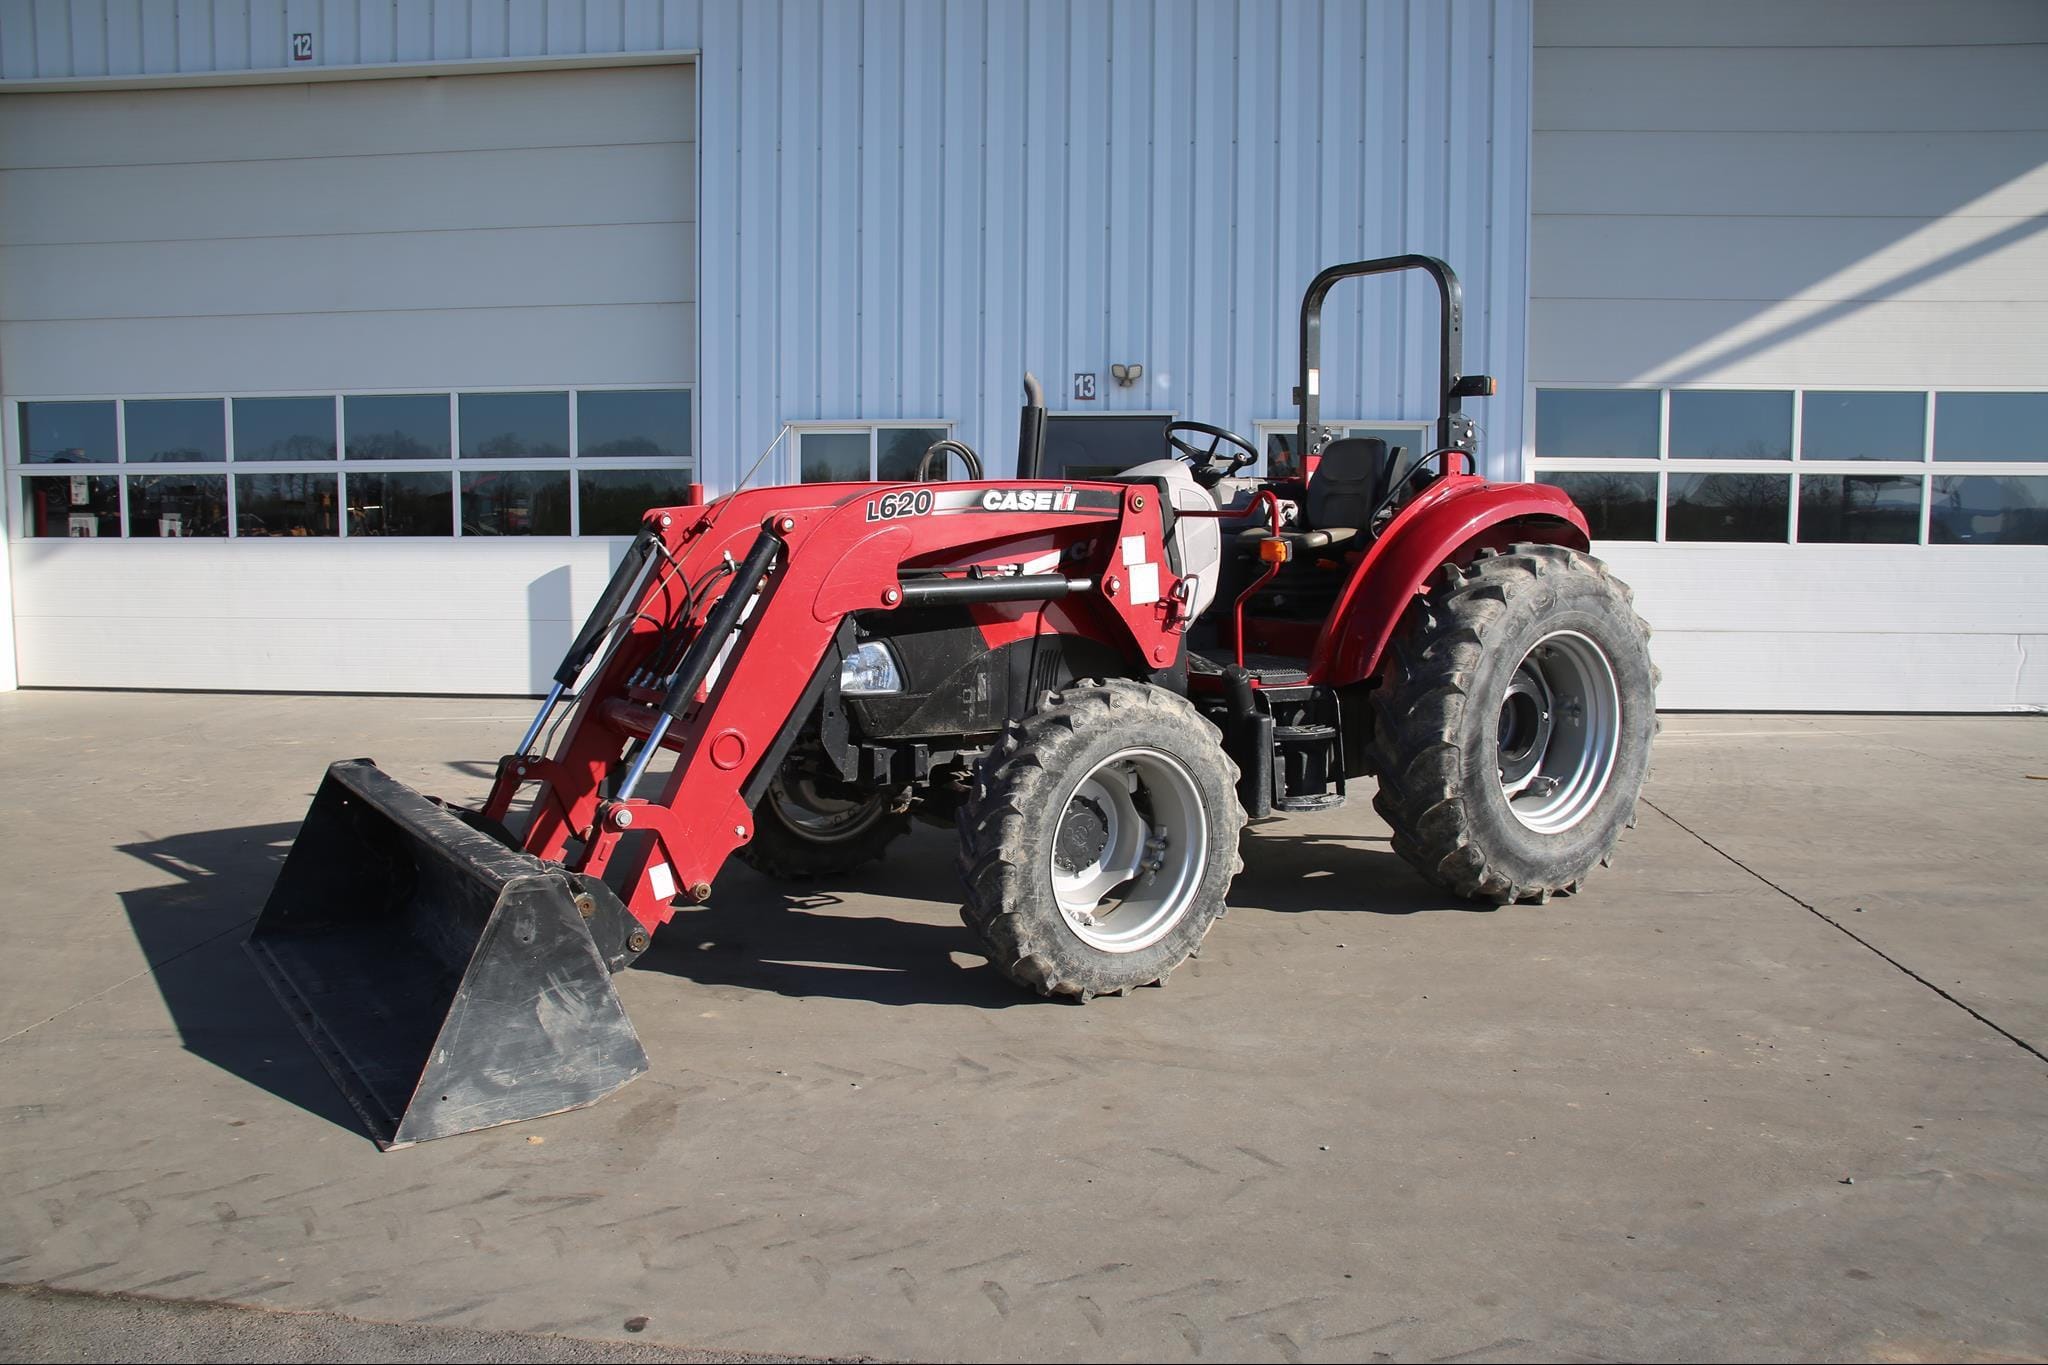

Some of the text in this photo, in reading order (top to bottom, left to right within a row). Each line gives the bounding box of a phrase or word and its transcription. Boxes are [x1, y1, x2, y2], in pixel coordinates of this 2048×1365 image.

[294, 35, 311, 56] 12
[1075, 375, 1095, 397] 13
[866, 489, 934, 522] L620
